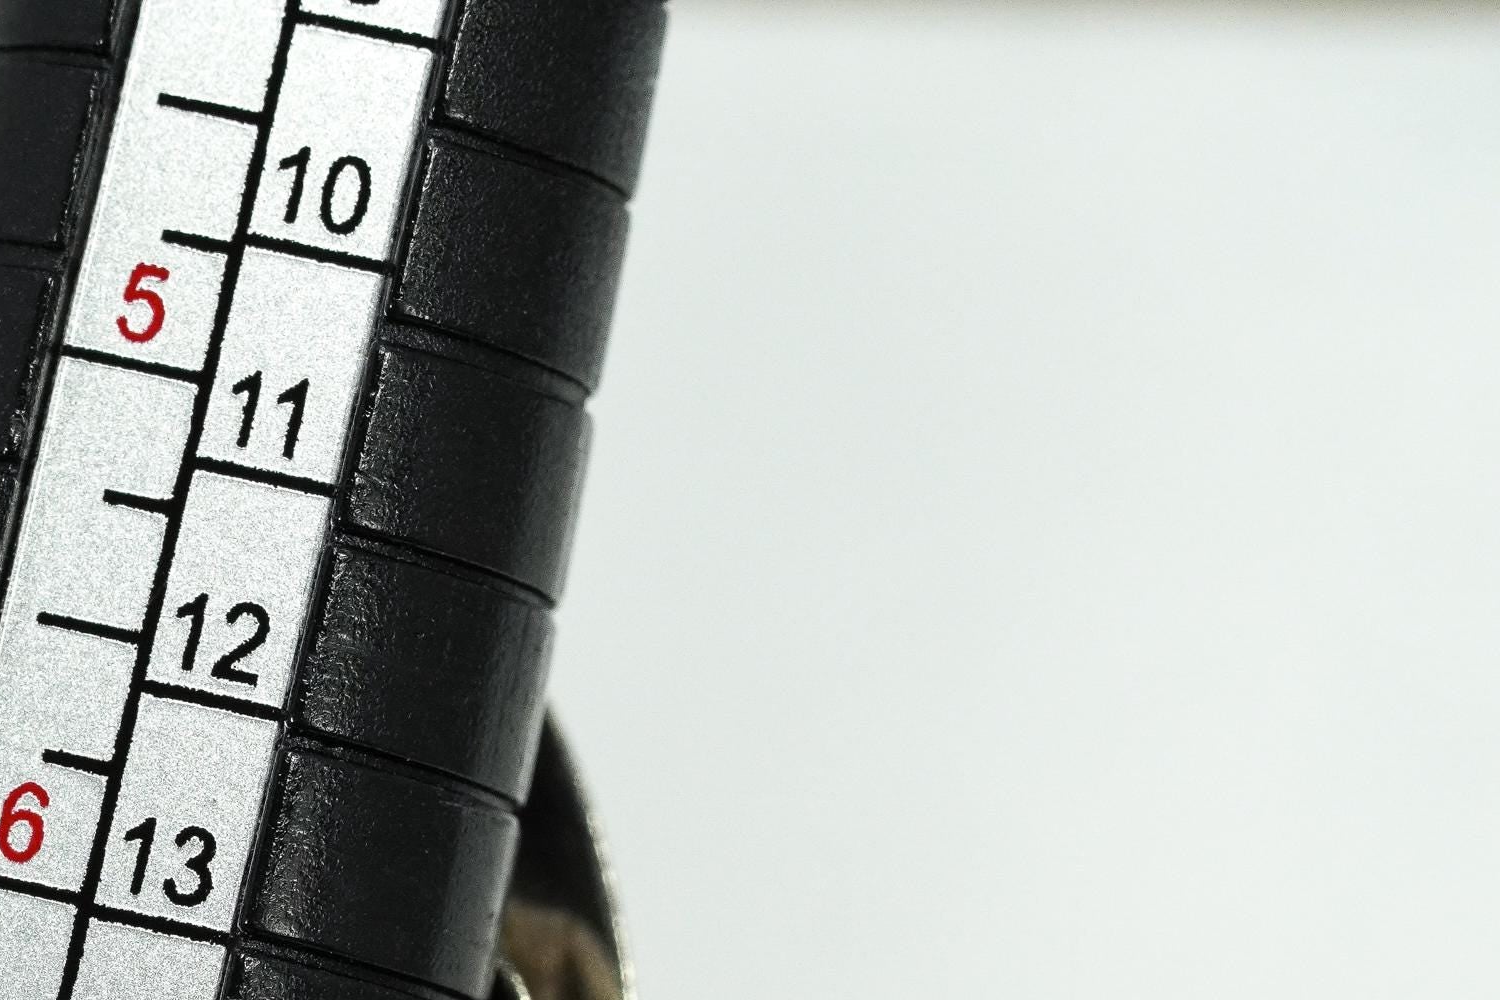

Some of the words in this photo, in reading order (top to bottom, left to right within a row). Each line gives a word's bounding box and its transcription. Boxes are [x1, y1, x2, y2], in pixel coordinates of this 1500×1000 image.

[278, 146, 372, 236] 10
[116, 262, 170, 343] 5
[232, 370, 310, 460] 11
[175, 592, 271, 688] 12
[123, 817, 217, 908] 13
